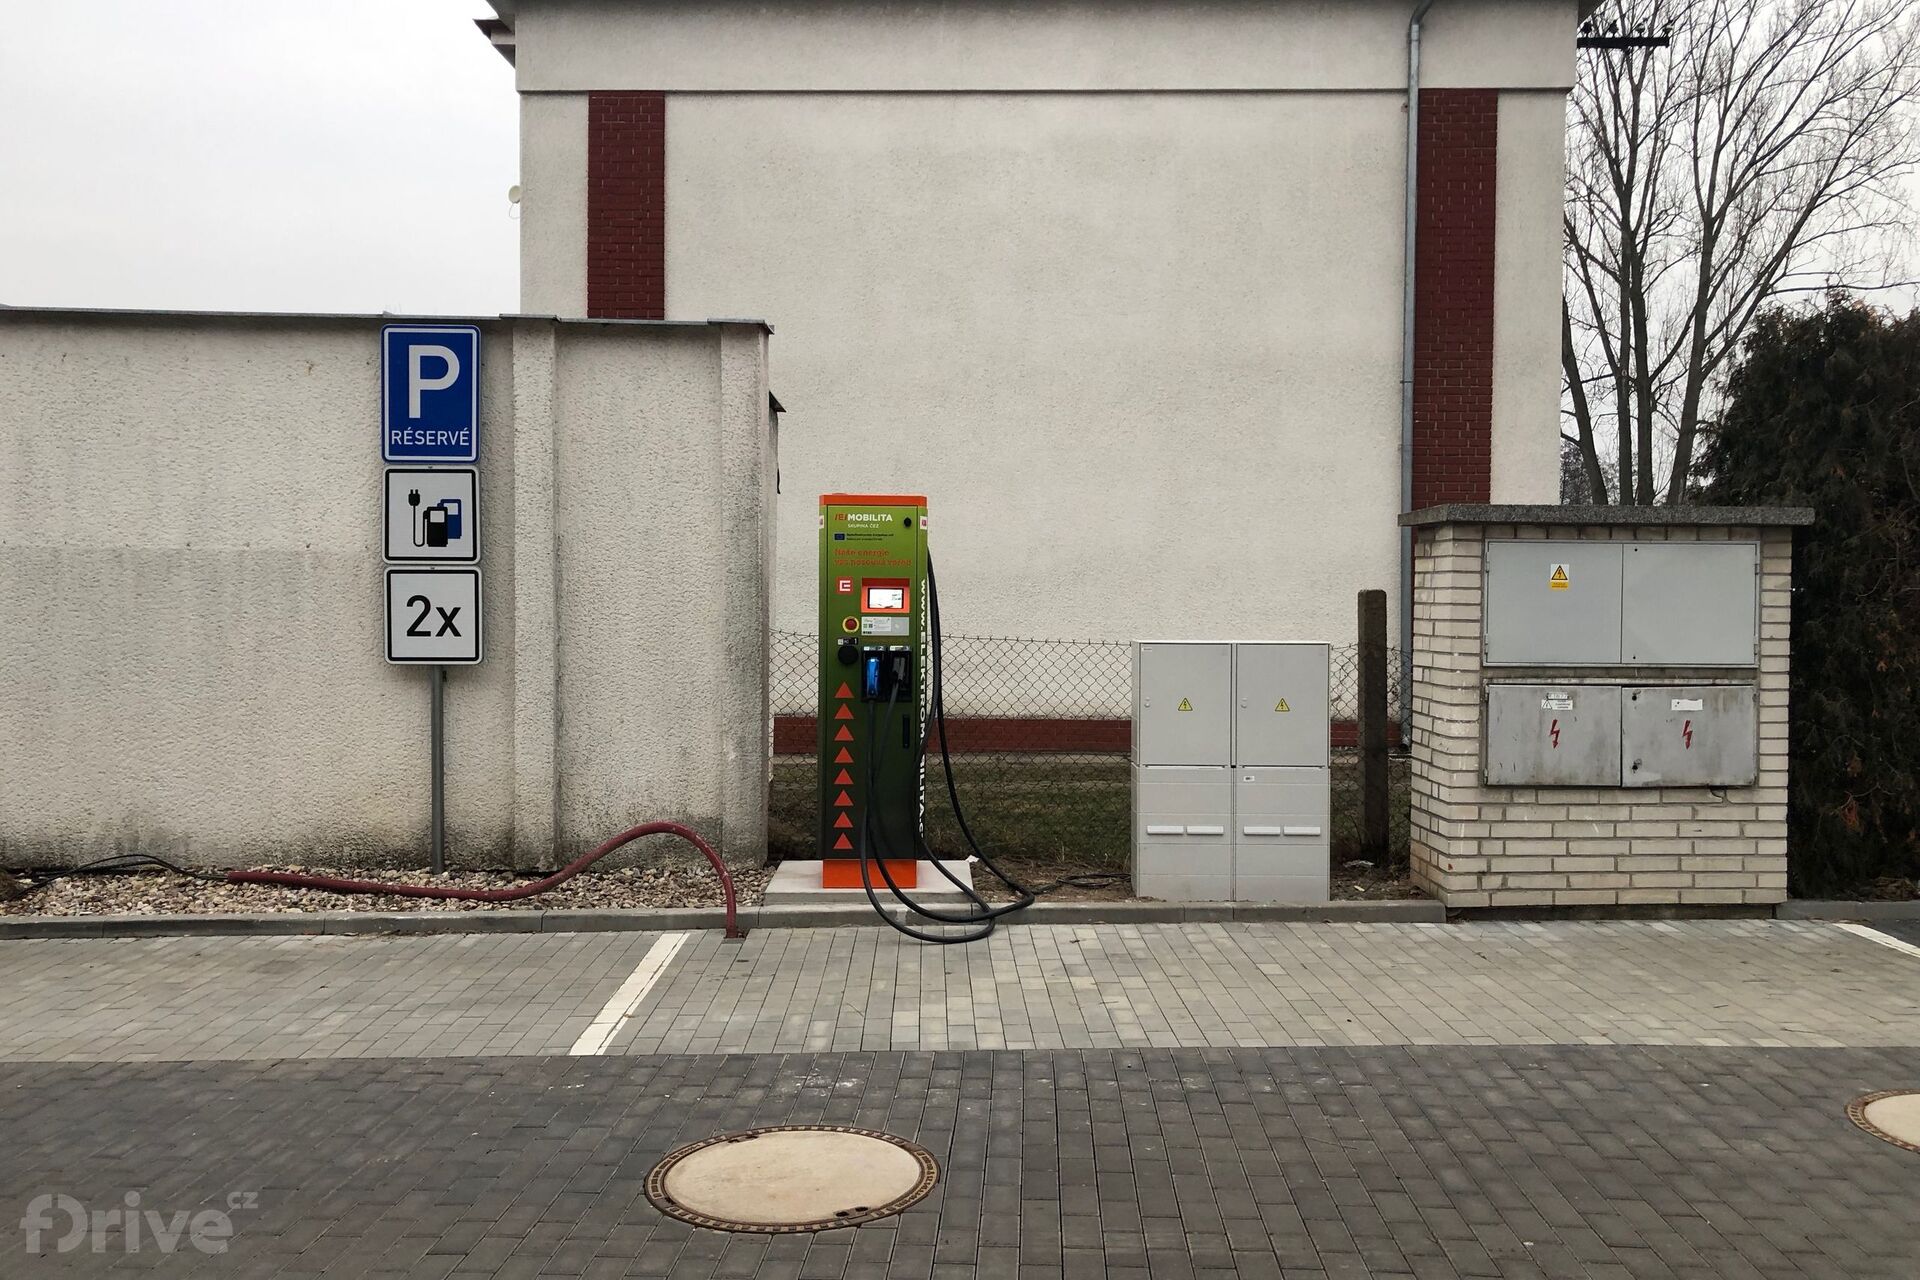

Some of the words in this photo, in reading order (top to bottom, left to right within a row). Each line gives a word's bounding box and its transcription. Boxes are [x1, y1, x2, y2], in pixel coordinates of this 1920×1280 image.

[408, 344, 460, 419] P
[391, 426, 470, 446] RÉSERVÉ
[406, 594, 462, 637] 2x
